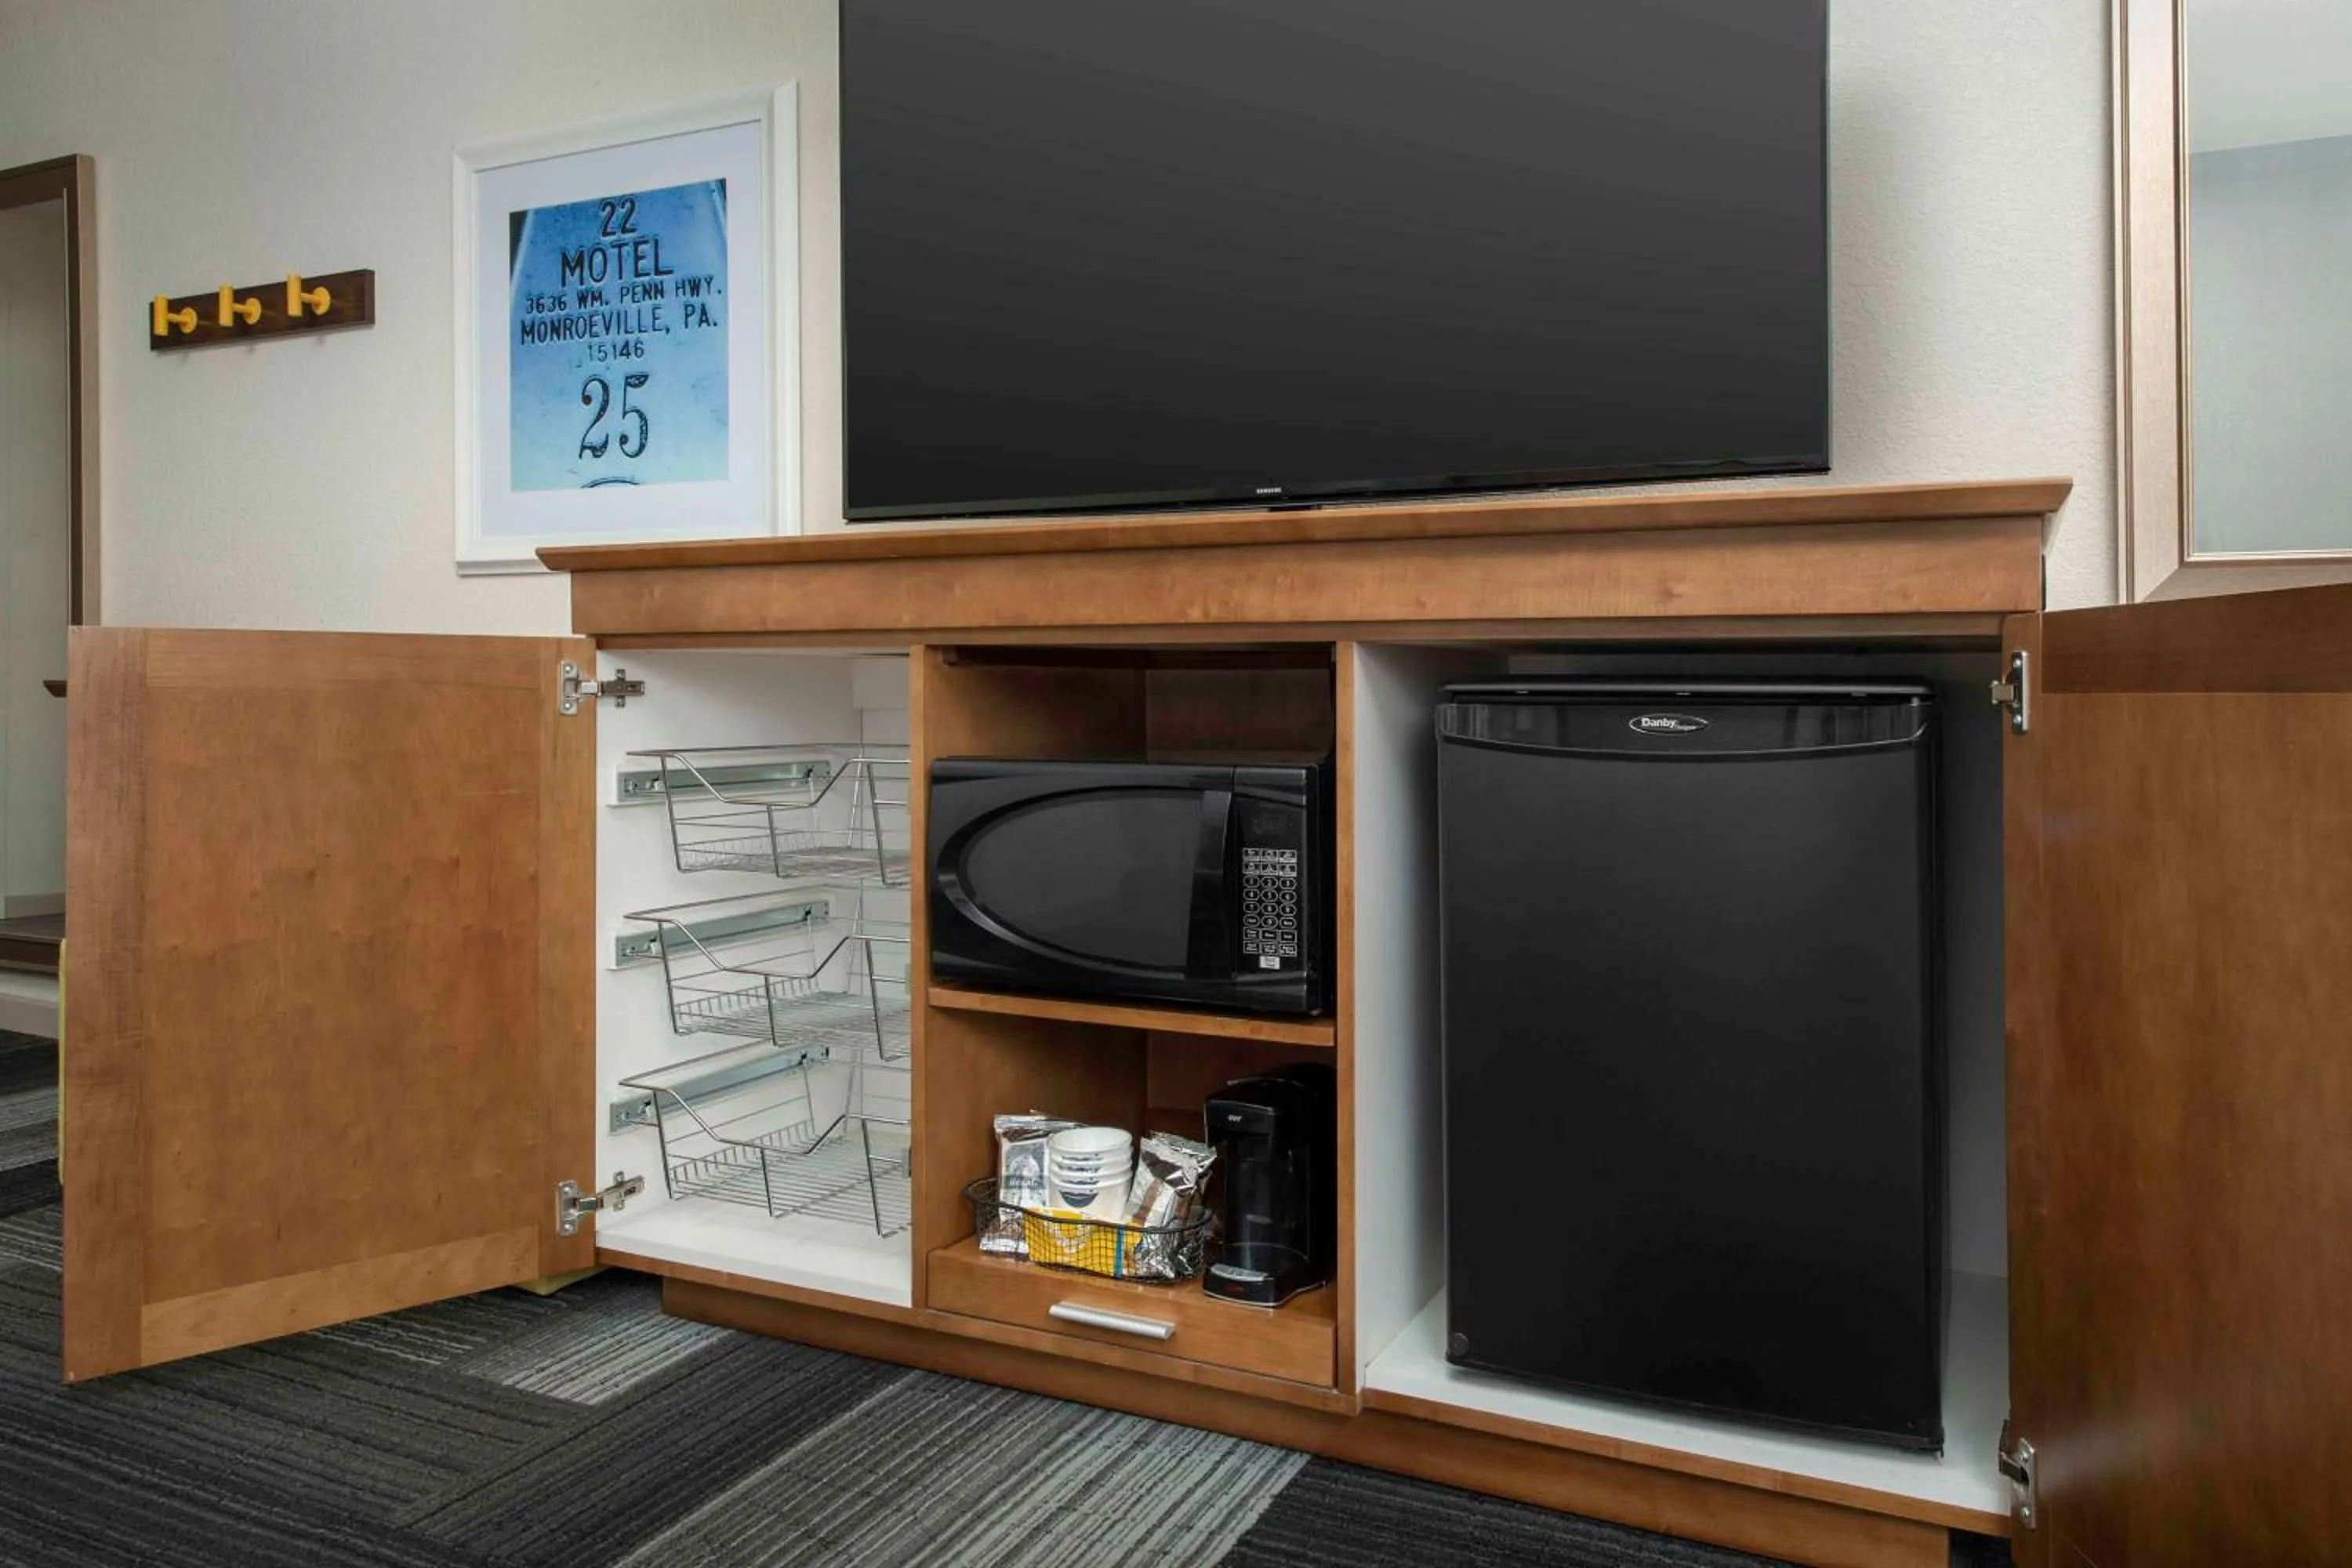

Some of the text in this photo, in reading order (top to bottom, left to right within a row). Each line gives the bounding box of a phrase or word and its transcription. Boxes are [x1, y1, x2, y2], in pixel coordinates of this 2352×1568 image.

[601, 198, 637, 237] 22
[561, 238, 674, 288] MOTEL
[526, 276, 722, 314] 3636 WM. PENN HWY.
[520, 303, 718, 345] MONROEVILLE, PA.
[589, 340, 644, 363] 15146
[579, 372, 650, 460] 25
[1641, 717, 1676, 728] Danby
